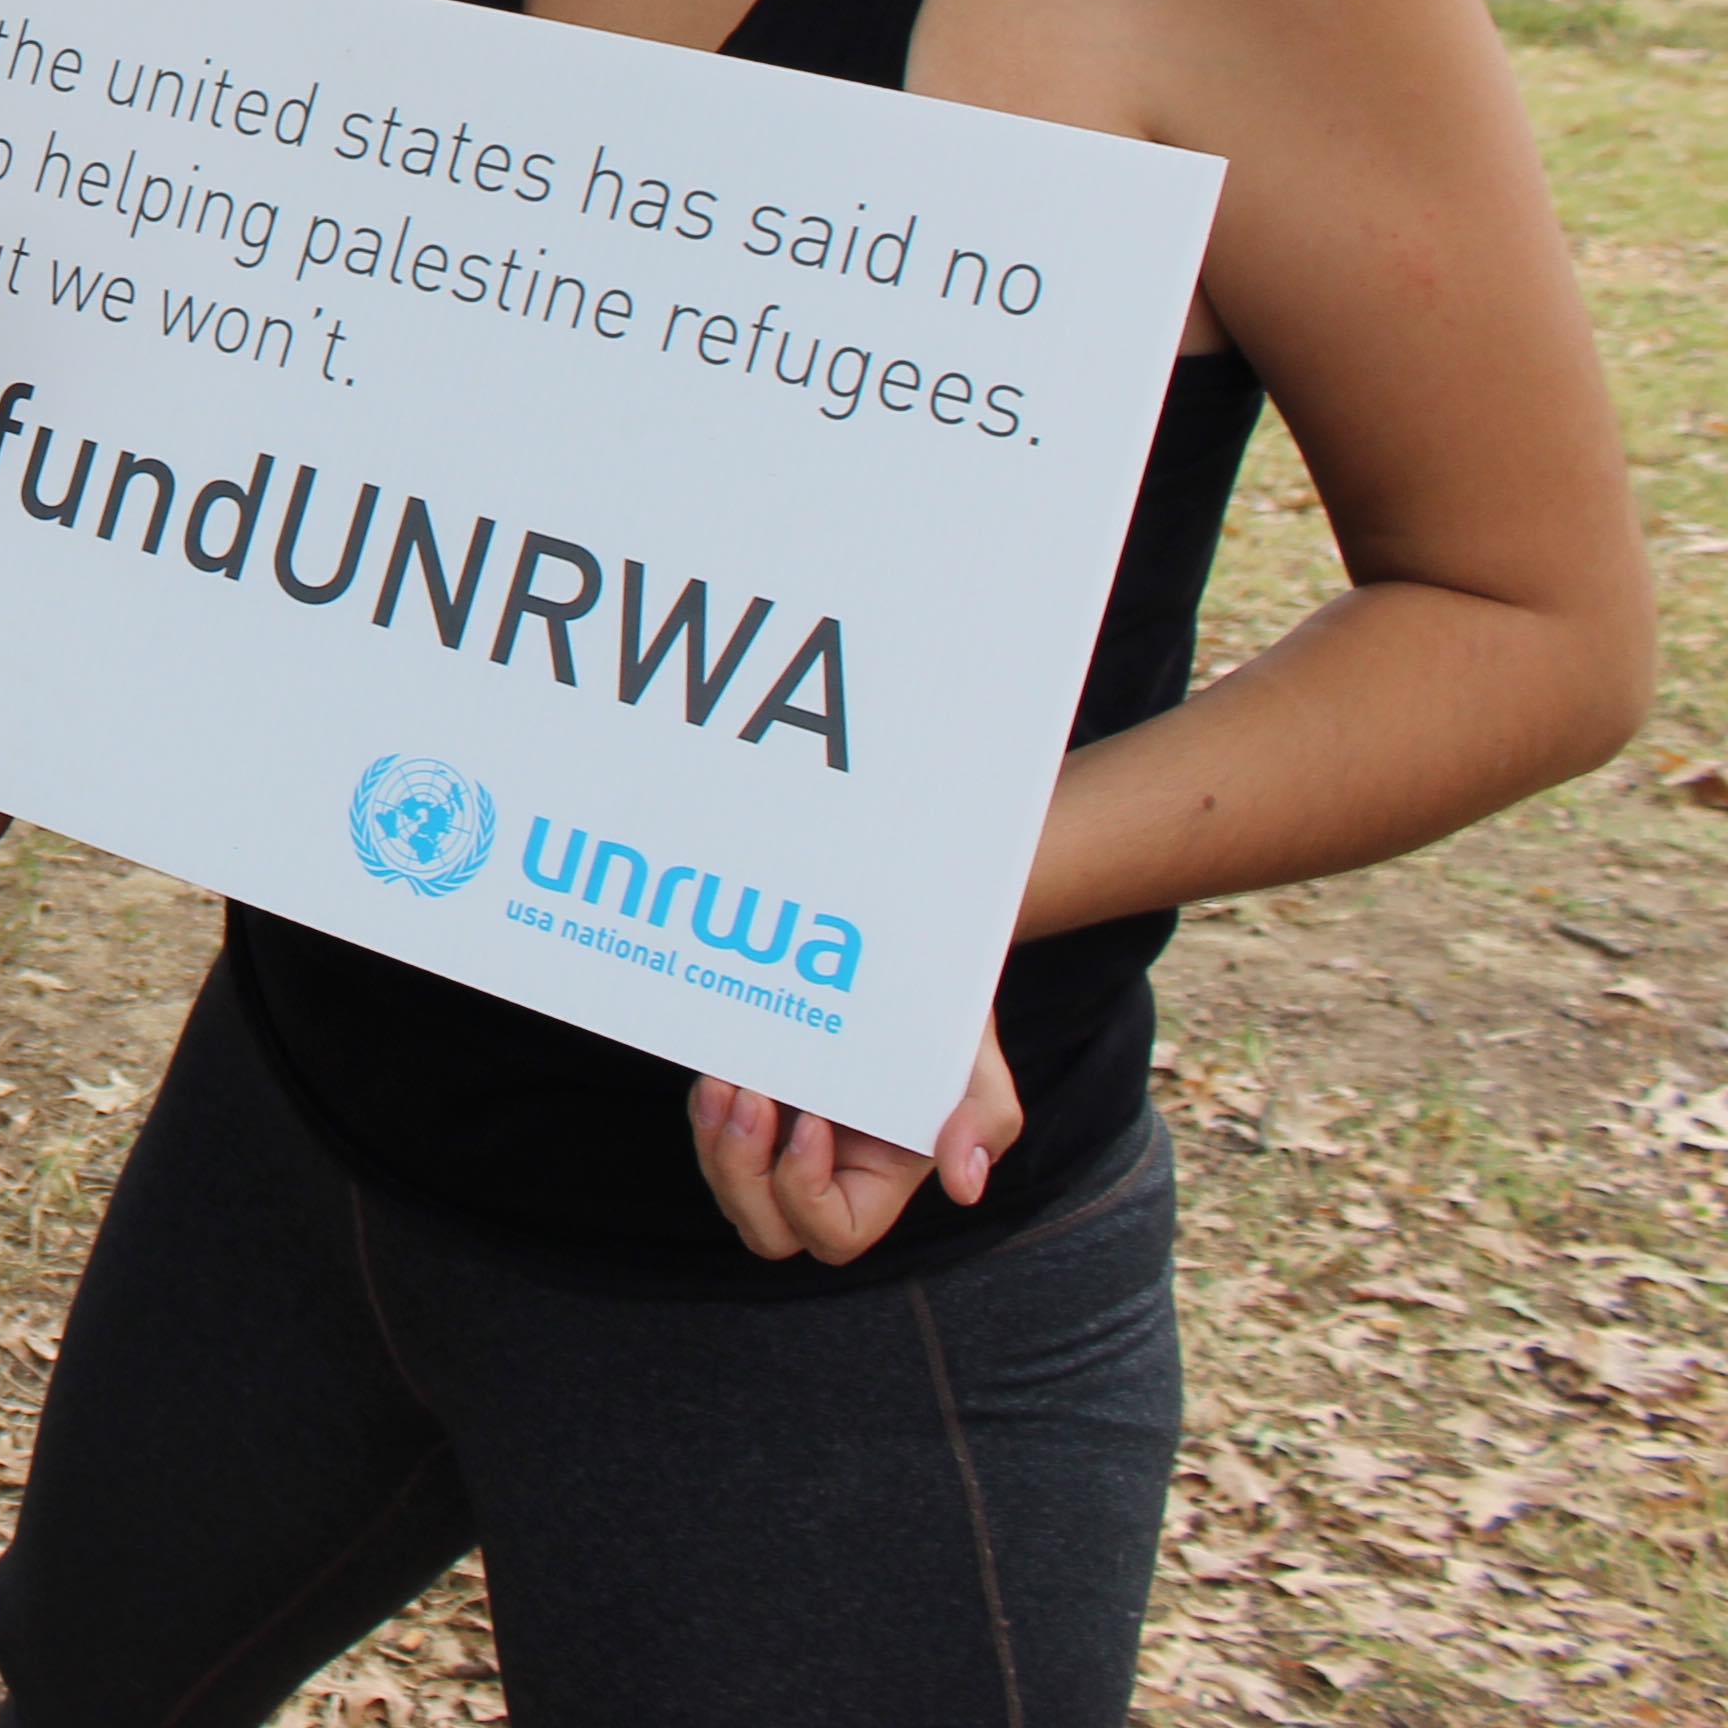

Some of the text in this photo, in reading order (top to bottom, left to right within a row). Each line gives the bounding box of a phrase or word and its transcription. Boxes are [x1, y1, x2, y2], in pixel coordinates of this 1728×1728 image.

[106, 58, 321, 148] united
[333, 105, 557, 204] states
[580, 144, 720, 242] has
[742, 204, 919, 288] said
[940, 247, 1044, 317] no
[33, 129, 281, 270] helping
[295, 214, 635, 340] palestine
[661, 303, 1042, 448] refugees.
[51, 258, 137, 324] we
[162, 288, 356, 388] won't.
[505, 899, 844, 1036] usa national committee
[521, 814, 865, 995] unrwa
